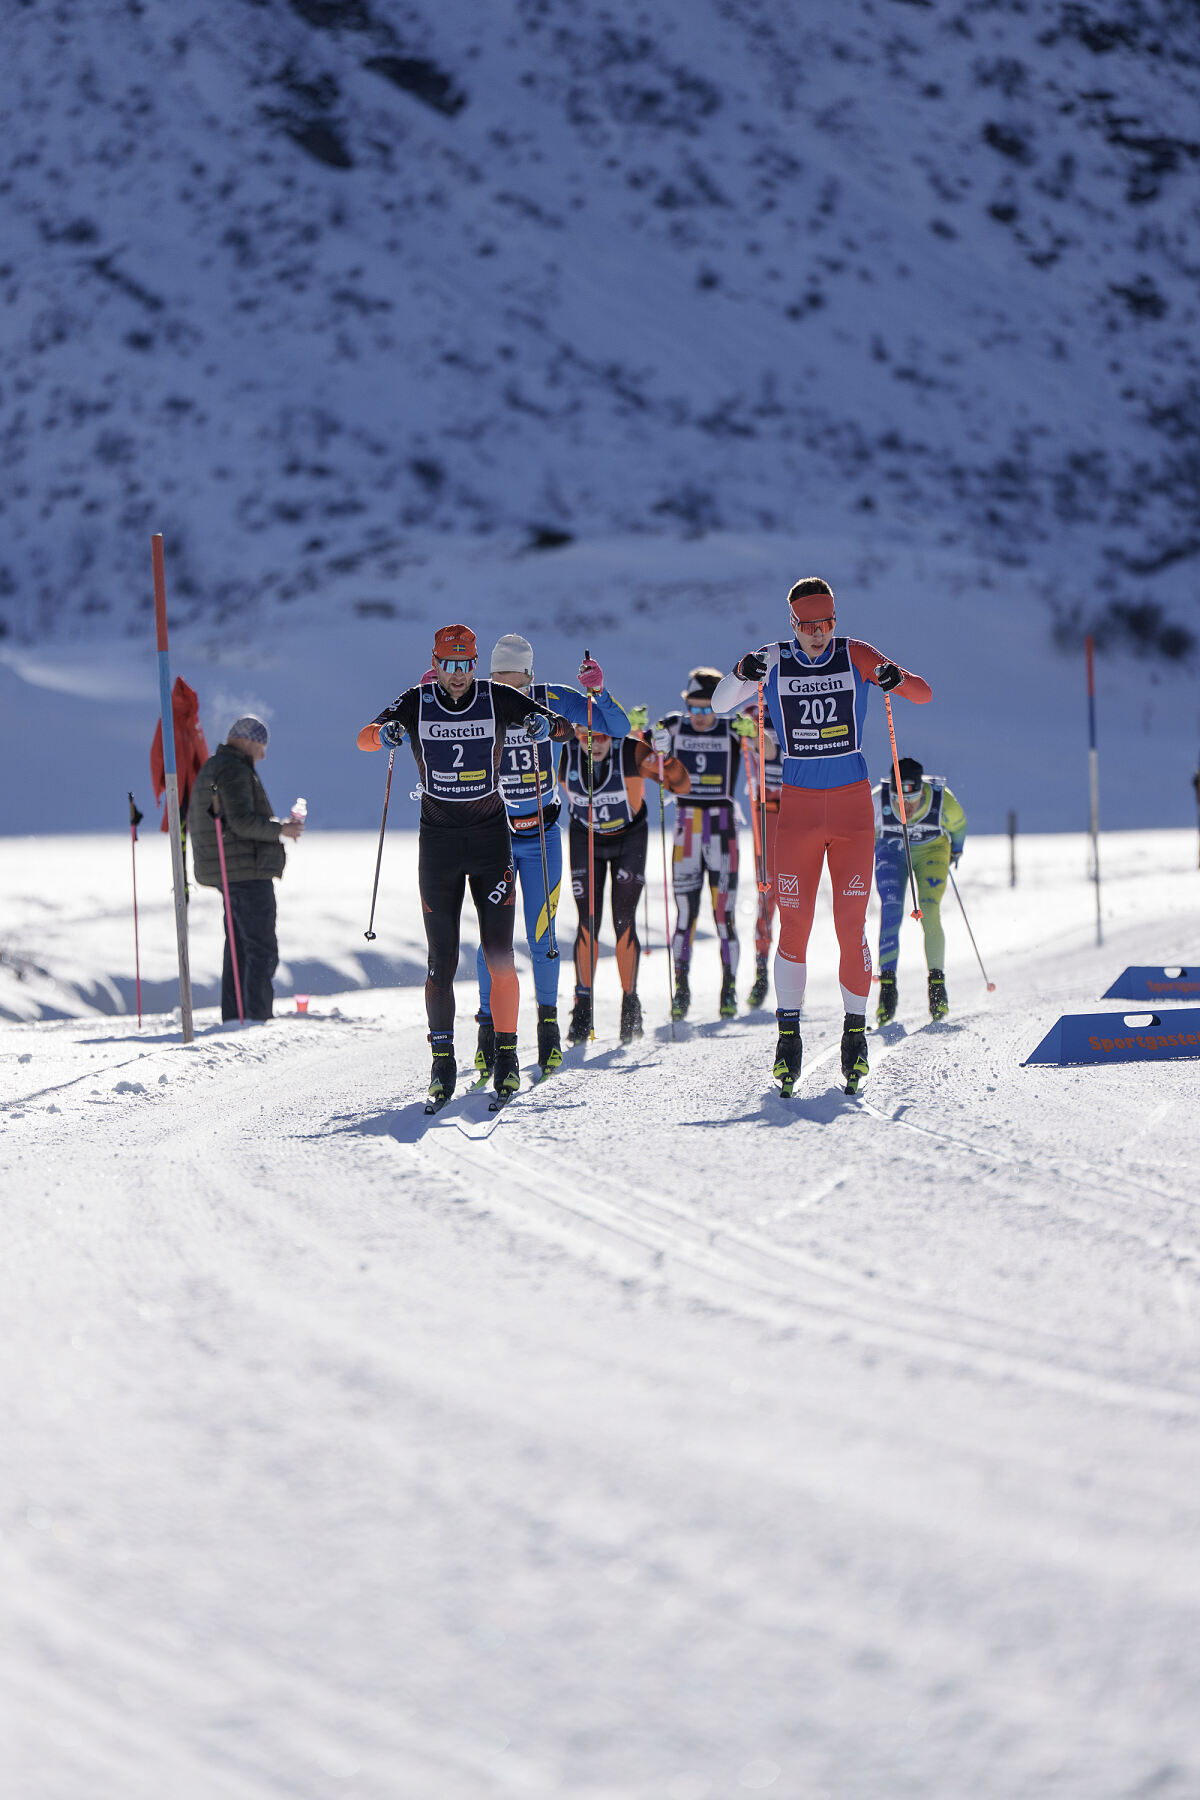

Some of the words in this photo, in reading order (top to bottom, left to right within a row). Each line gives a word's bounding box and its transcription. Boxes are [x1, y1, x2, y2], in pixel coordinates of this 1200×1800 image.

[788, 677, 844, 693] Gastein
[798, 697, 838, 725] 202
[428, 723, 485, 738] Gastein
[793, 740, 850, 751] Sportgastein
[452, 743, 464, 768] 2
[508, 749, 532, 771] 13
[695, 752, 707, 773] 9
[433, 783, 486, 793] Sportgastein
[592, 805, 610, 822] 14
[1088, 1031, 1200, 1053] Sportgastei
